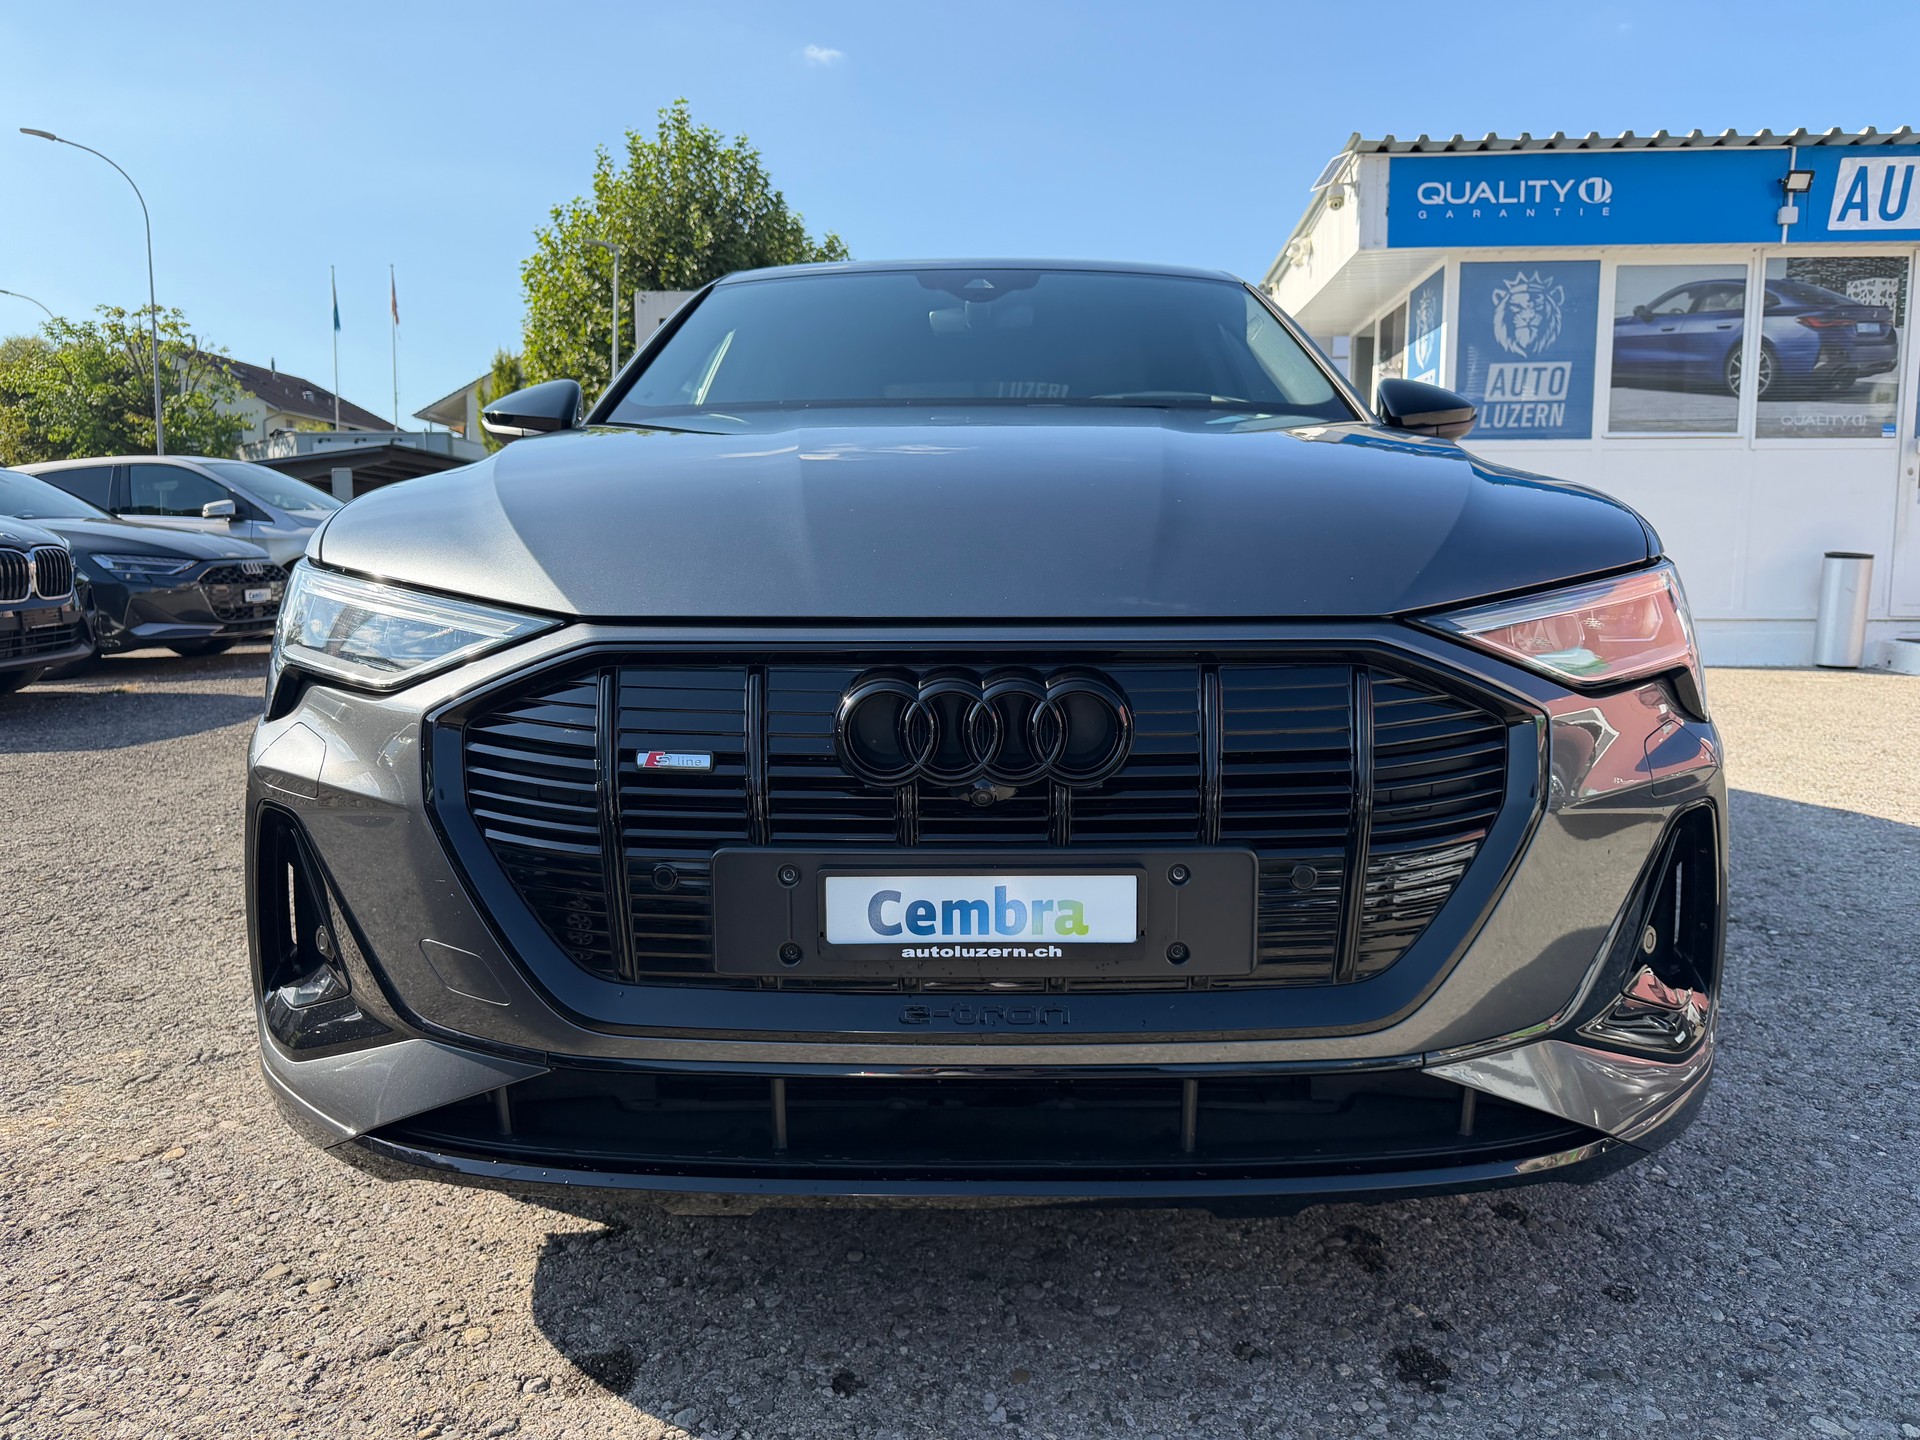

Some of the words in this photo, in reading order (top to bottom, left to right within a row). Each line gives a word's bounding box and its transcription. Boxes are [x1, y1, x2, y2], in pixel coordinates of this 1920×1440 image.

[1417, 179, 1575, 205] QUALITY
[1418, 207, 1610, 219] GARANTIE
[1489, 366, 1566, 397] AUTO
[1480, 402, 1565, 428] LUZERN
[677, 757, 702, 766] line
[867, 885, 1089, 937] Cembra
[901, 946, 1063, 958] autoluzern.ch
[898, 1001, 1071, 1026] e-tron
